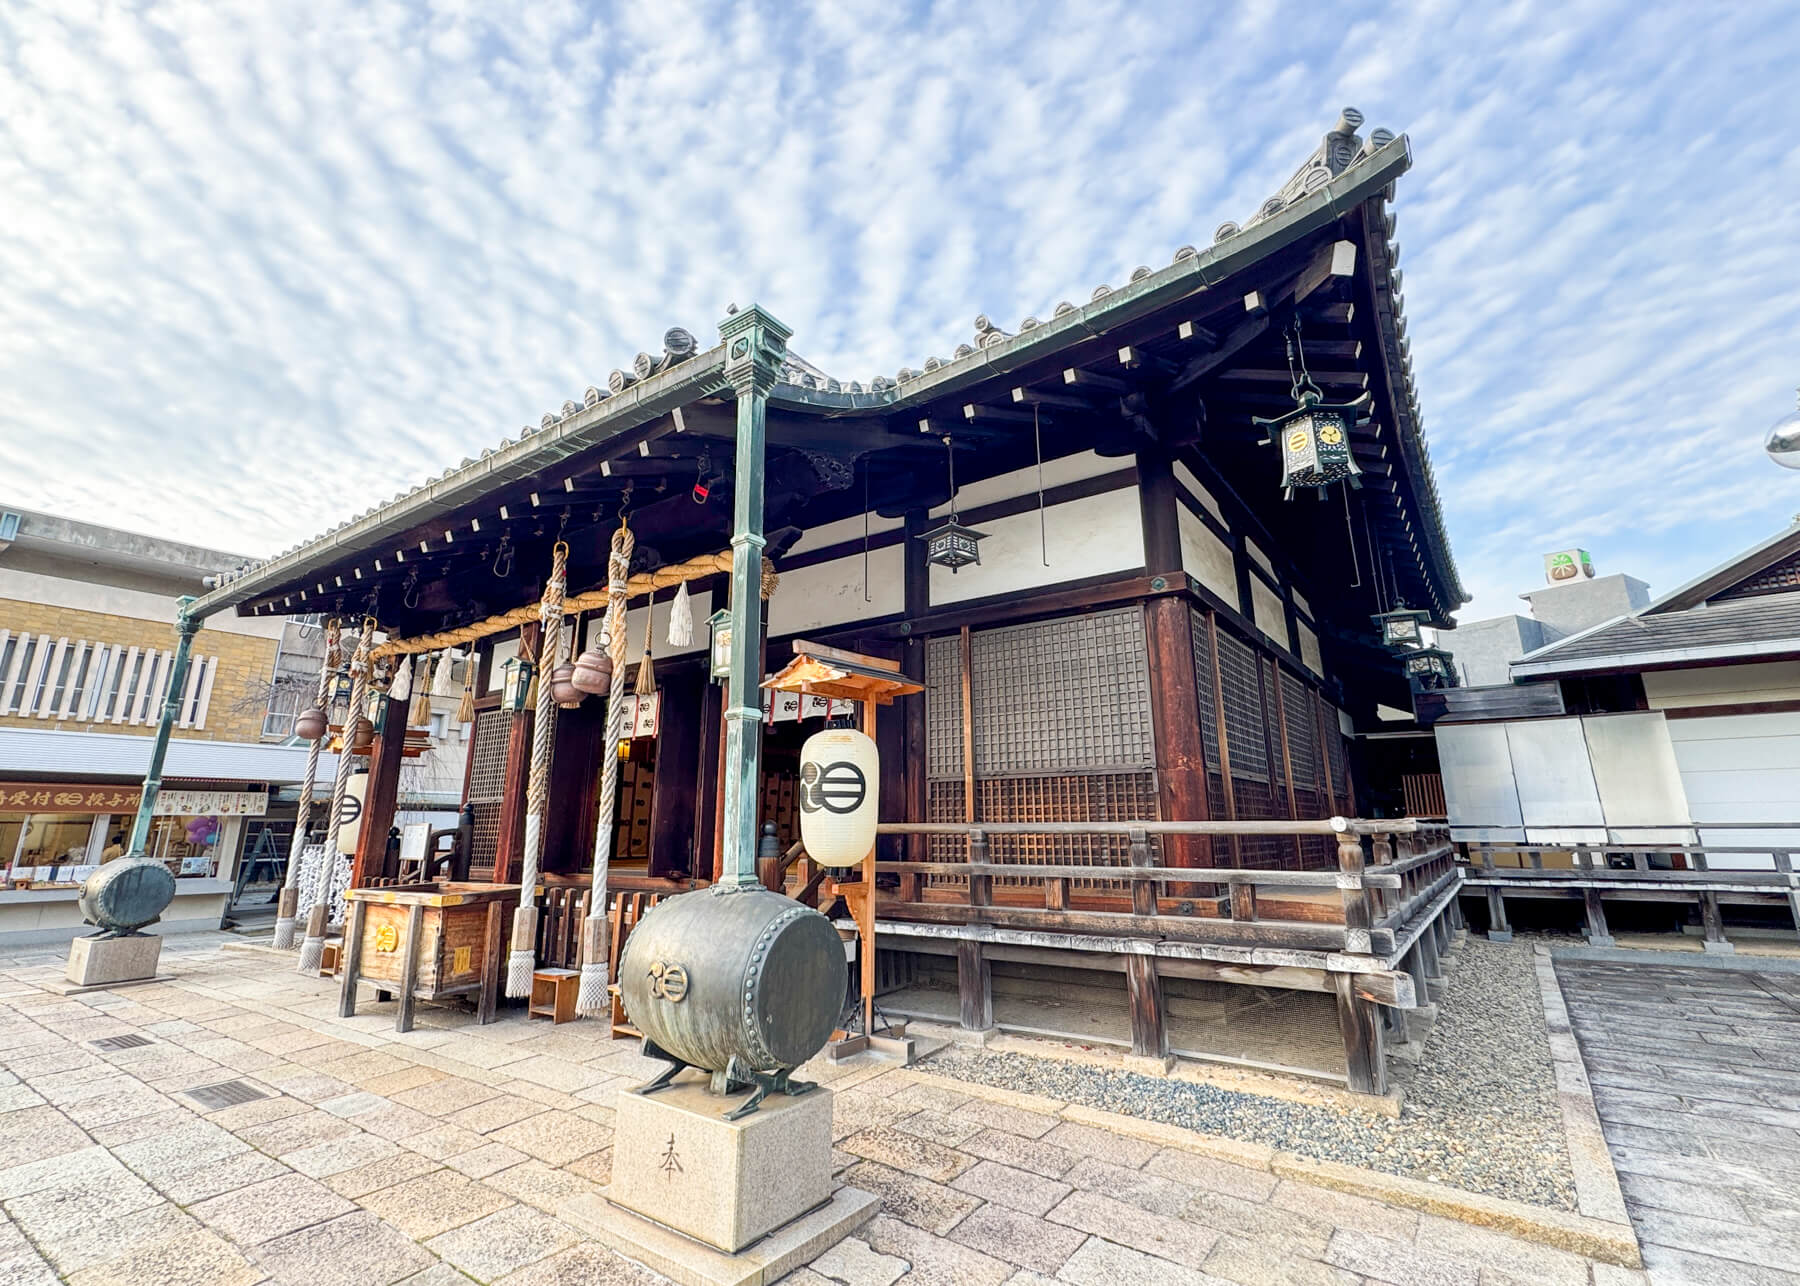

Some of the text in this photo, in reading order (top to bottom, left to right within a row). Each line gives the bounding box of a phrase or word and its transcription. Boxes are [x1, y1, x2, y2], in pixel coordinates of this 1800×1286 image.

[86, 792, 141, 807] 授与所
[660, 1132, 684, 1184] 奉
